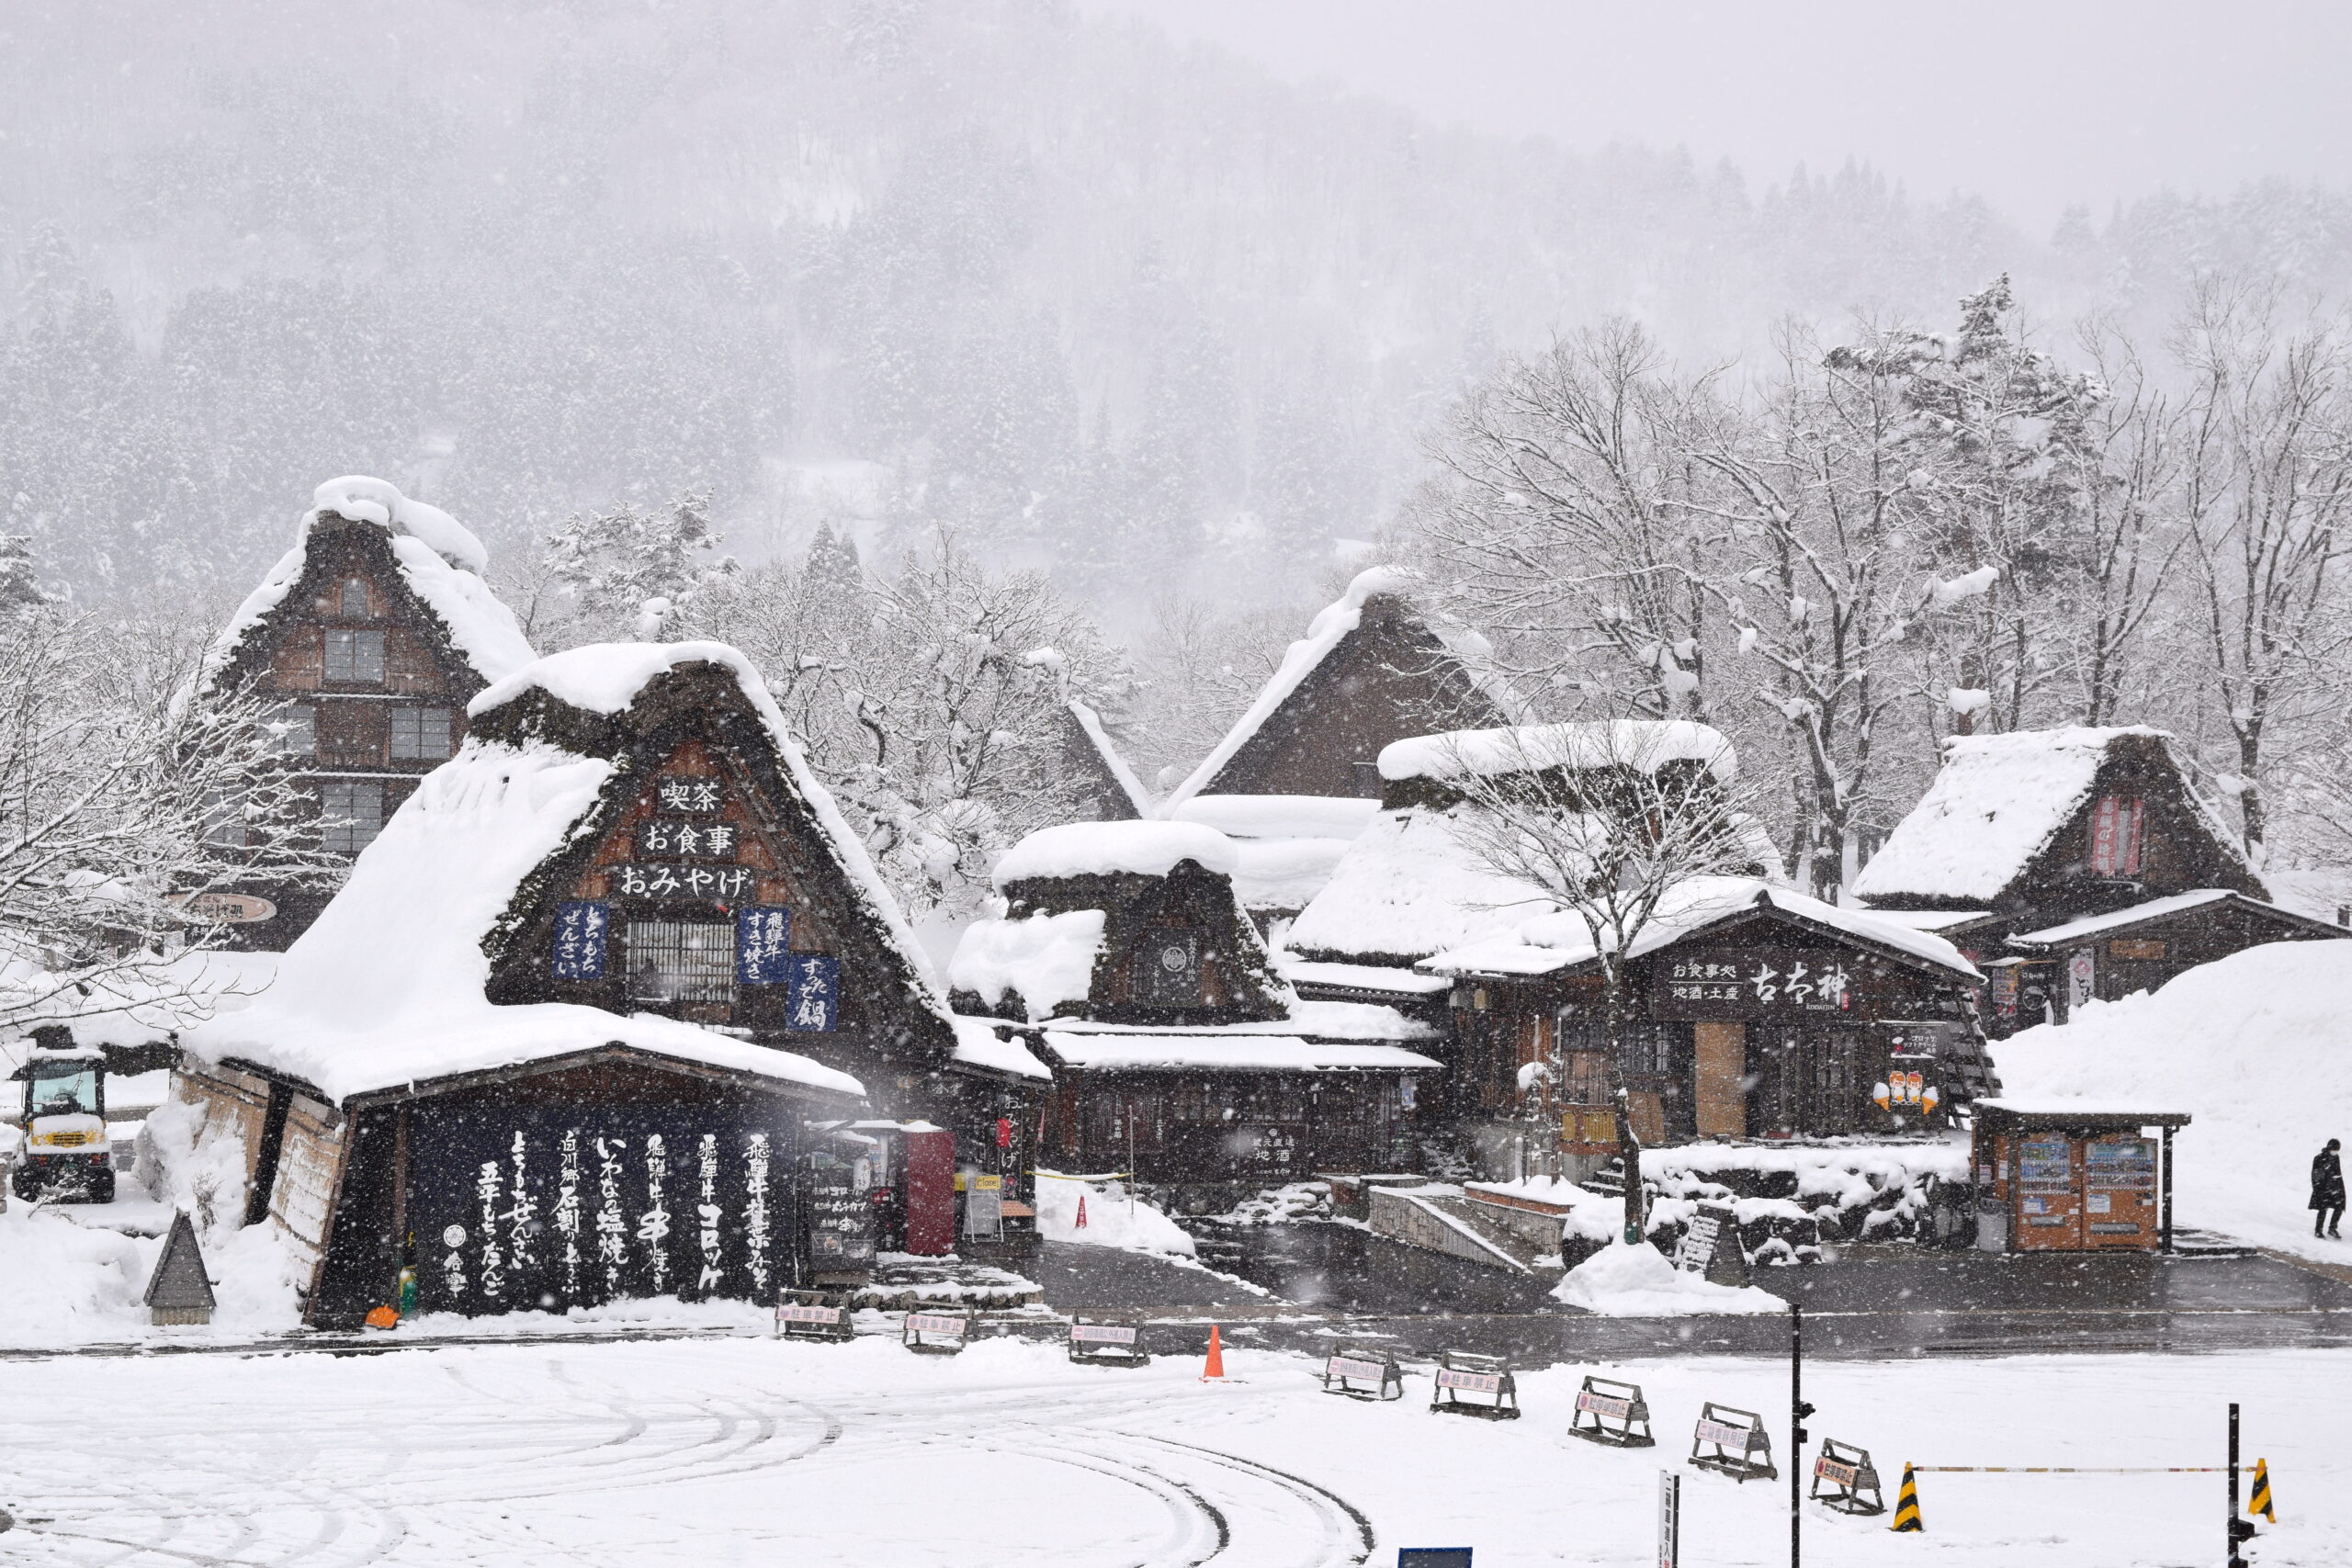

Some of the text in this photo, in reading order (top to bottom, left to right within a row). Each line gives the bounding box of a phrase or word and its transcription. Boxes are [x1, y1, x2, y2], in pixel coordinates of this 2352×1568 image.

[660, 783, 719, 812] 喫茶
[645, 825, 733, 855] お食事
[620, 866, 751, 897] おみやげ
[558, 908, 584, 975] ぜんざい
[582, 906, 605, 973] とちもち
[744, 912, 767, 980] すき焼き
[763, 910, 785, 962] 飛騨牛
[1672, 964, 1736, 978] お食事処
[1672, 987, 1739, 1000] 地酒・土産
[1254, 1150, 1290, 1162] 地酒
[596, 1136, 629, 1292] いわなの塩焼き
[638, 1134, 672, 1292] 飛騨牛串焼き
[697, 1134, 724, 1290] 飛騨牛コロッケ
[791, 1308, 835, 1321] 駐車禁止
[920, 1318, 961, 1331] 駐車禁止
[1451, 1373, 1495, 1391] 駐車禁止
[1589, 1397, 1626, 1416] 駐停車禁止
[1824, 1462, 1853, 1483] 駐停車禁止
